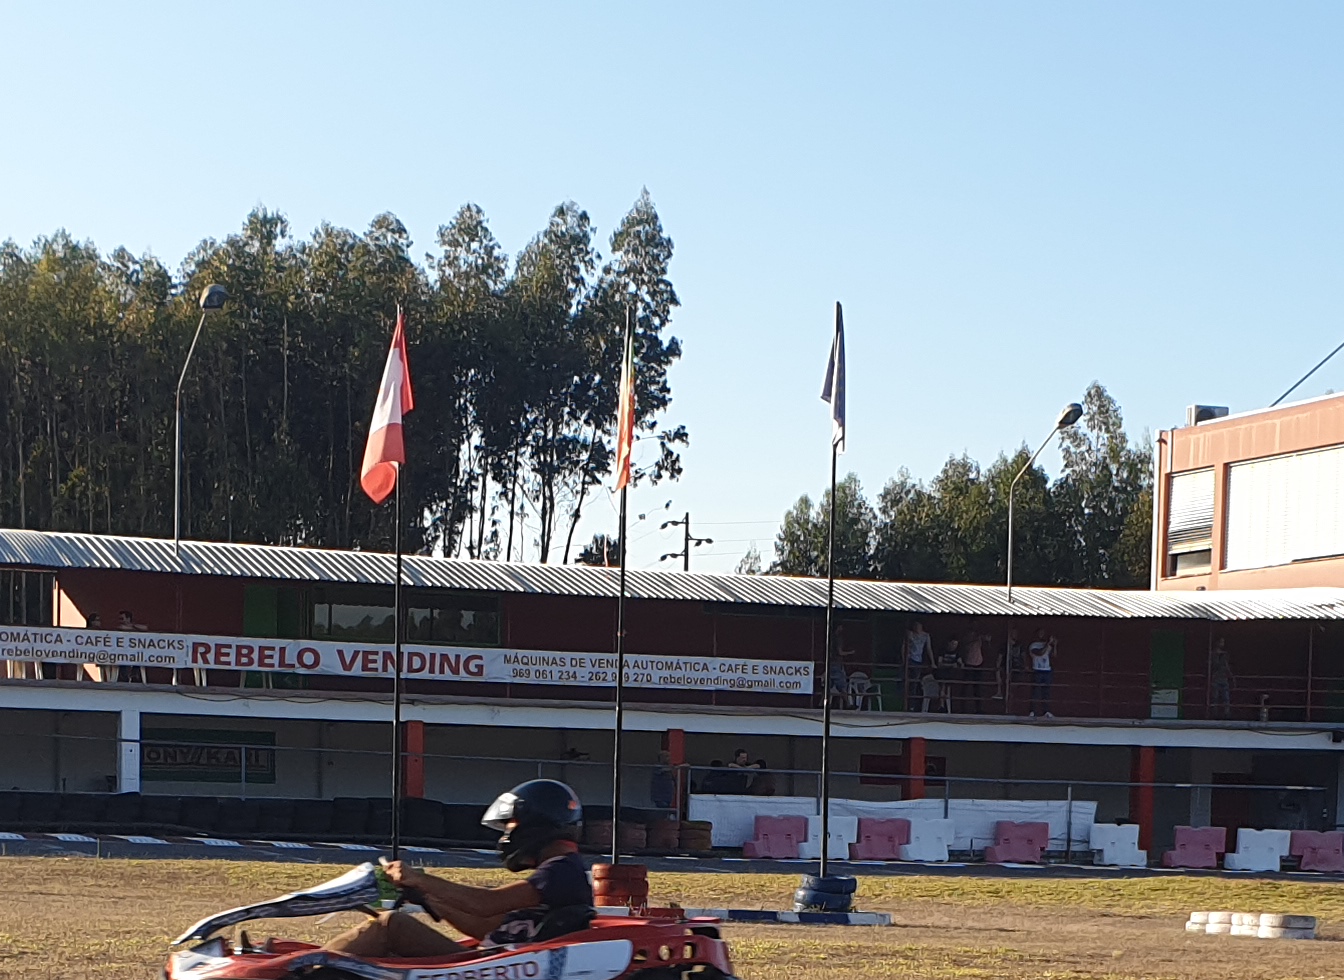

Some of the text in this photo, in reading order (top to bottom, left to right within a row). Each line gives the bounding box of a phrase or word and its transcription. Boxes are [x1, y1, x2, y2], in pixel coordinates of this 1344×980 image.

[75, 634, 111, 647] CAFÉ
[116, 637, 124, 647] E
[128, 637, 185, 651] SNACKS
[1, 645, 176, 664] rebelovending@gmail.com
[191, 641, 485, 677] REBELO VENDING
[503, 653, 566, 667] MÁQUINAS
[570, 658, 586, 668] DE
[590, 658, 630, 669] VENA
[633, 659, 709, 673] AUTOMÁTICA
[719, 662, 748, 674] CAFÉ
[751, 664, 759, 675] E
[762, 665, 810, 677] SNACKS
[512, 668, 531, 678] 969
[535, 669, 553, 679] 061
[557, 670, 577, 681] 234
[587, 671, 608, 682] 262
[611, 672, 630, 683] 99
[632, 672, 652, 683] 270
[658, 673, 802, 688] rebelovending@gmail.com
[418, 961, 539, 980] BERTO
